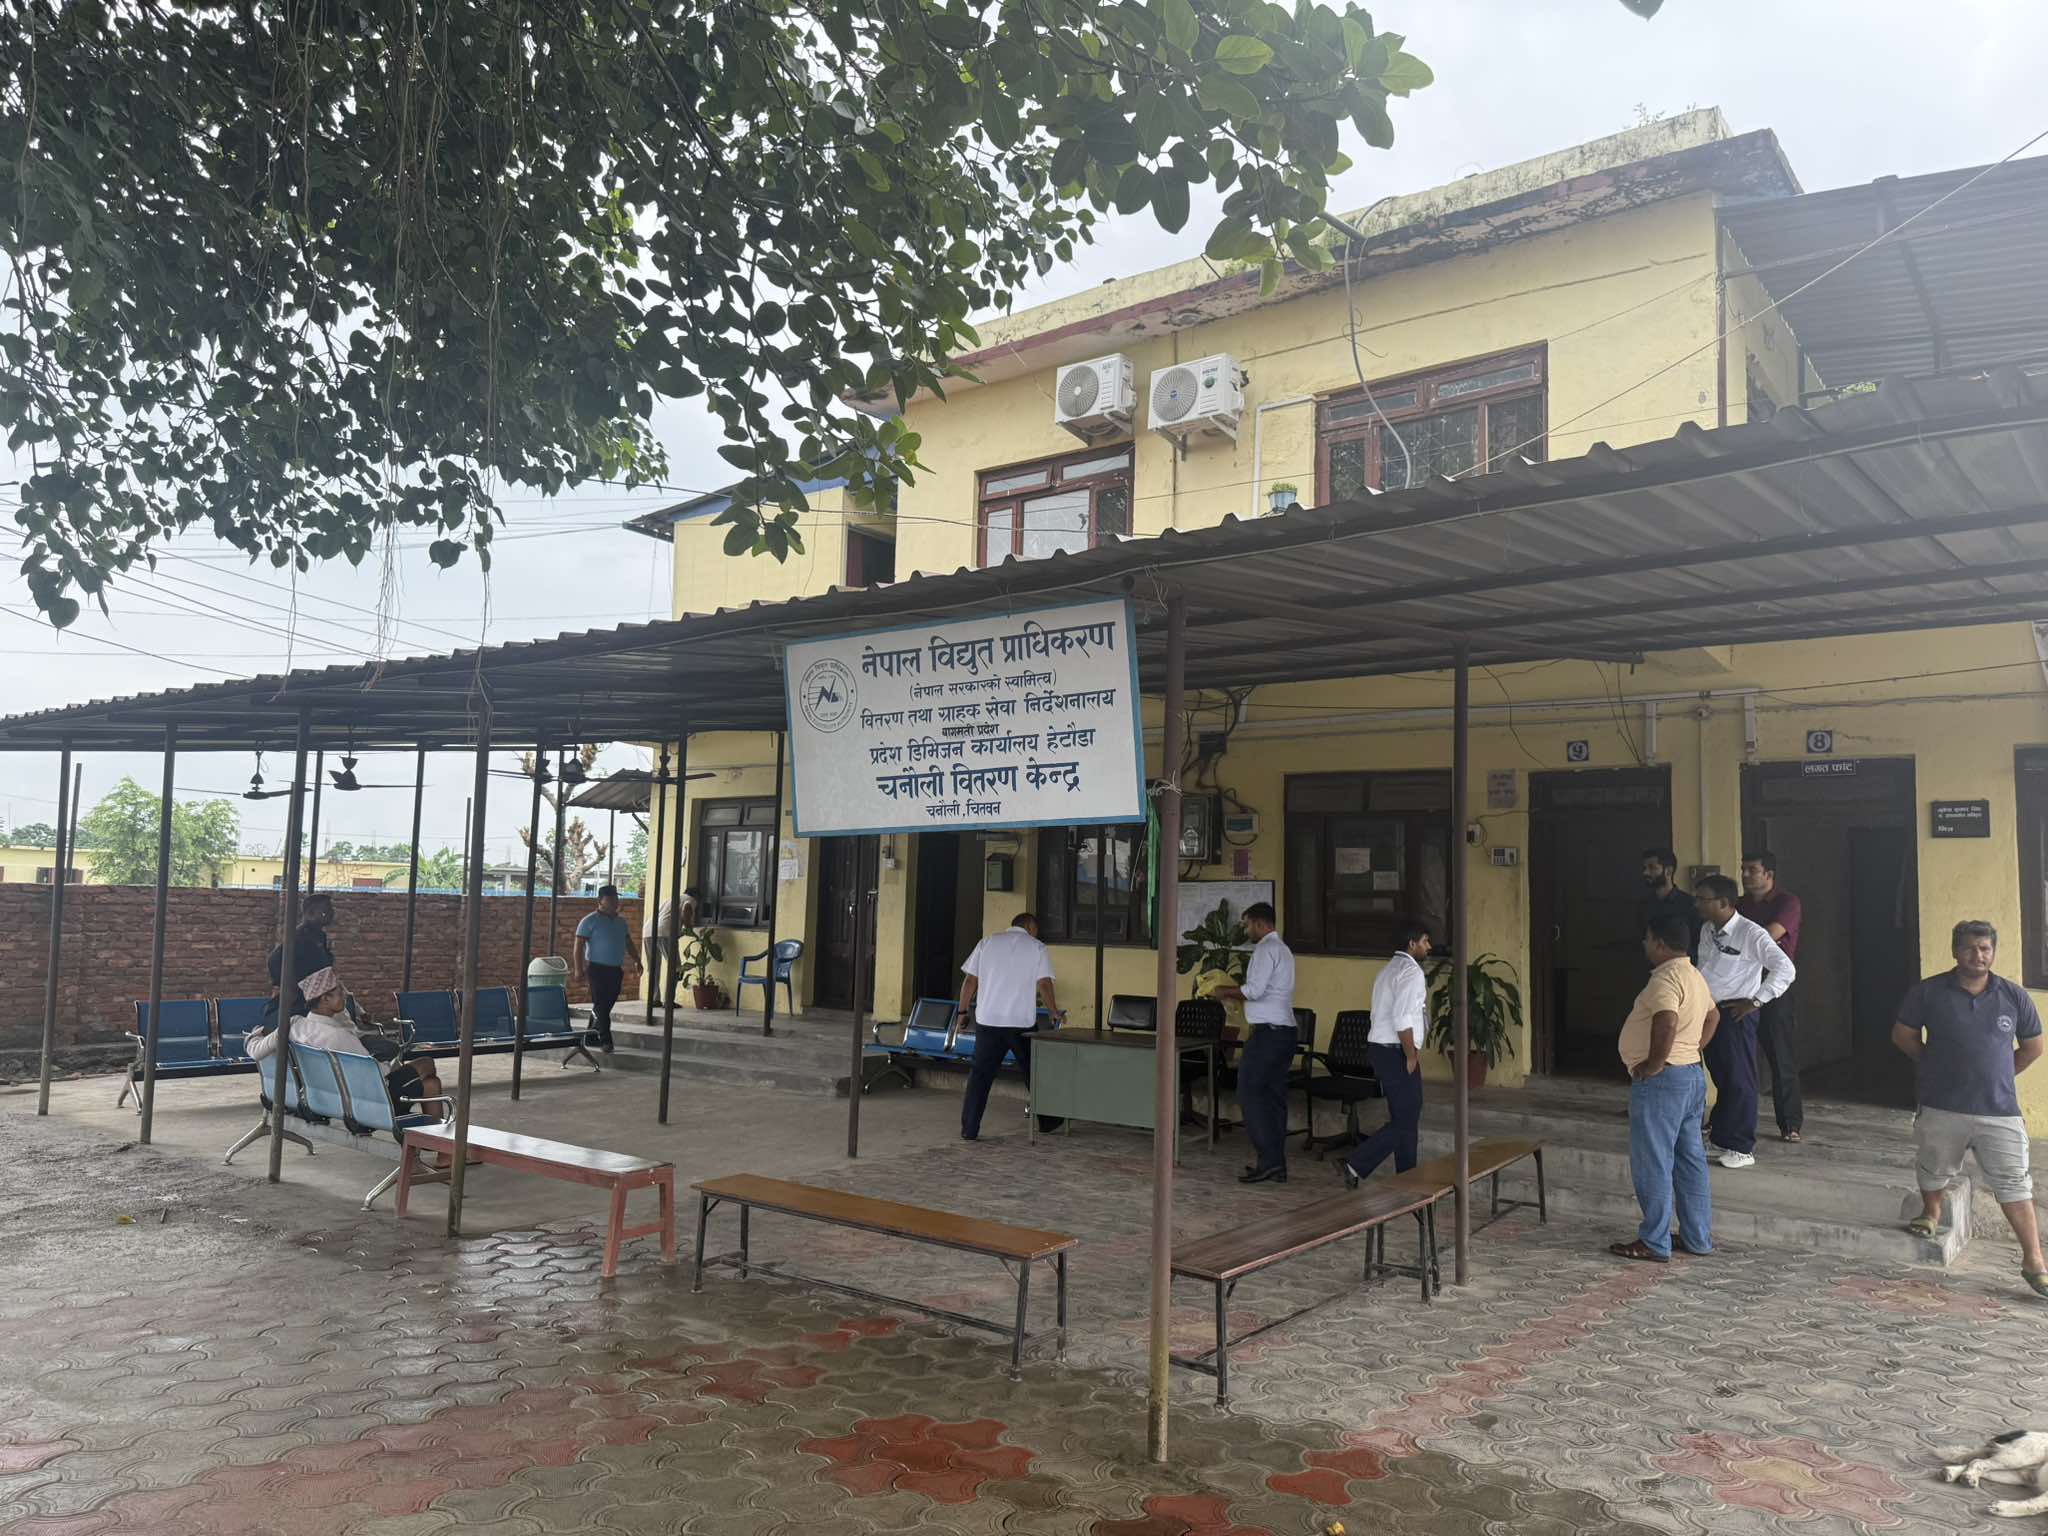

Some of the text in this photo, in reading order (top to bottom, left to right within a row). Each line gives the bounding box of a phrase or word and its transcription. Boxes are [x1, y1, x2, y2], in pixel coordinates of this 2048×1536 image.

[862, 645, 922, 678] नेपाल
[928, 635, 994, 675] विद्युत
[1000, 620, 1116, 663] प्राधिकरण
[948, 674, 1001, 696] सरकारको
[1005, 668, 1057, 692] स्वामित्व)
[860, 708, 905, 730] वितरण
[907, 708, 933, 727] तथा
[938, 703, 981, 724] ग्राहक
[985, 696, 1017, 720] सेवा
[1023, 688, 1117, 715] निर्देशनालय
[977, 721, 1000, 735] प्रदेश
[1813, 734, 1825, 749] 8
[869, 741, 902, 765] प्रदेश
[906, 736, 965, 761] डिभिजन
[970, 730, 1040, 756] कार्यालय
[876, 757, 1081, 800] चनौली वितरण केन्द्र
[966, 798, 1001, 817] चितवन
